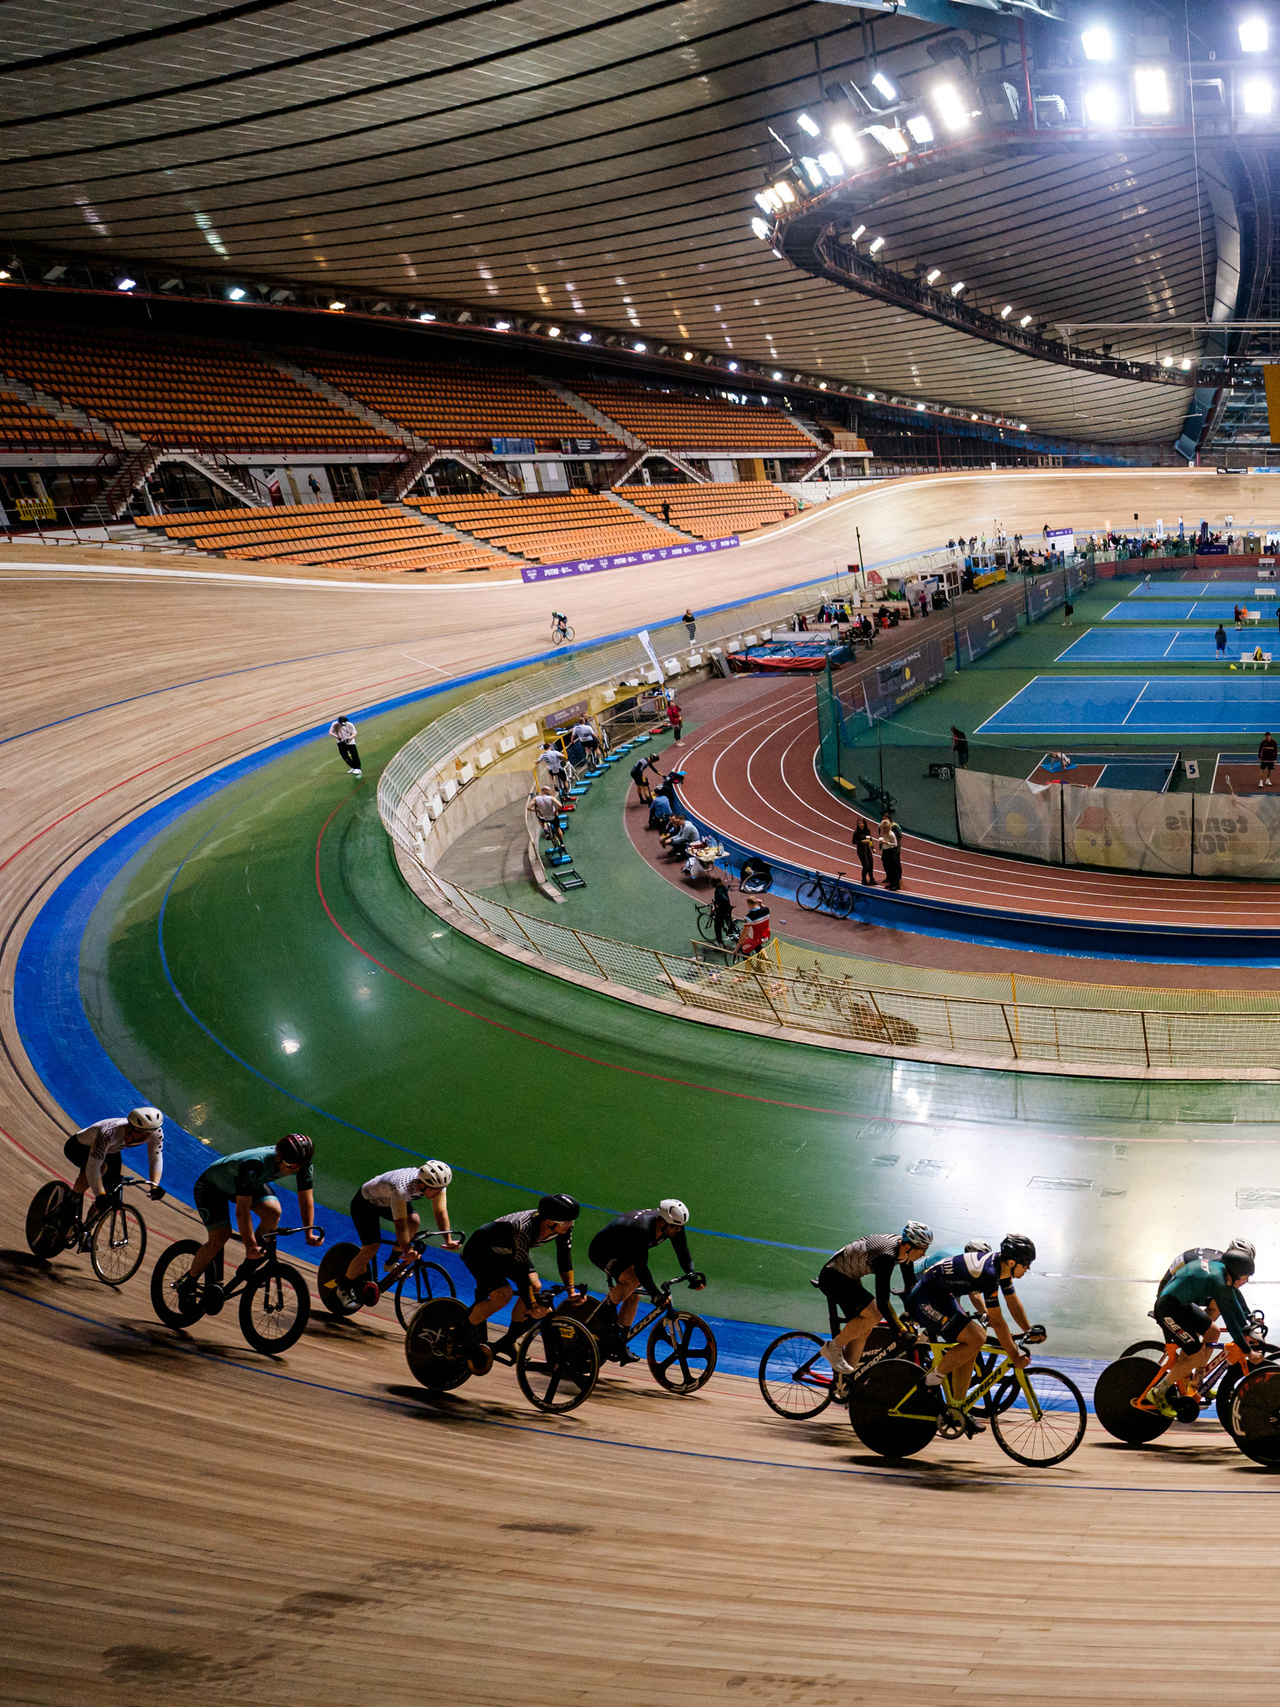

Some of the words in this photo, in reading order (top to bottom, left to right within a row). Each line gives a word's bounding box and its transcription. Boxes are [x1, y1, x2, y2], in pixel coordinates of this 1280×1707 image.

[1189, 764, 1196, 774] 5
[627, 1306, 663, 1339] LOOK
[853, 1349, 888, 1381] ARGON
[962, 1367, 1004, 1408] MERIDA
